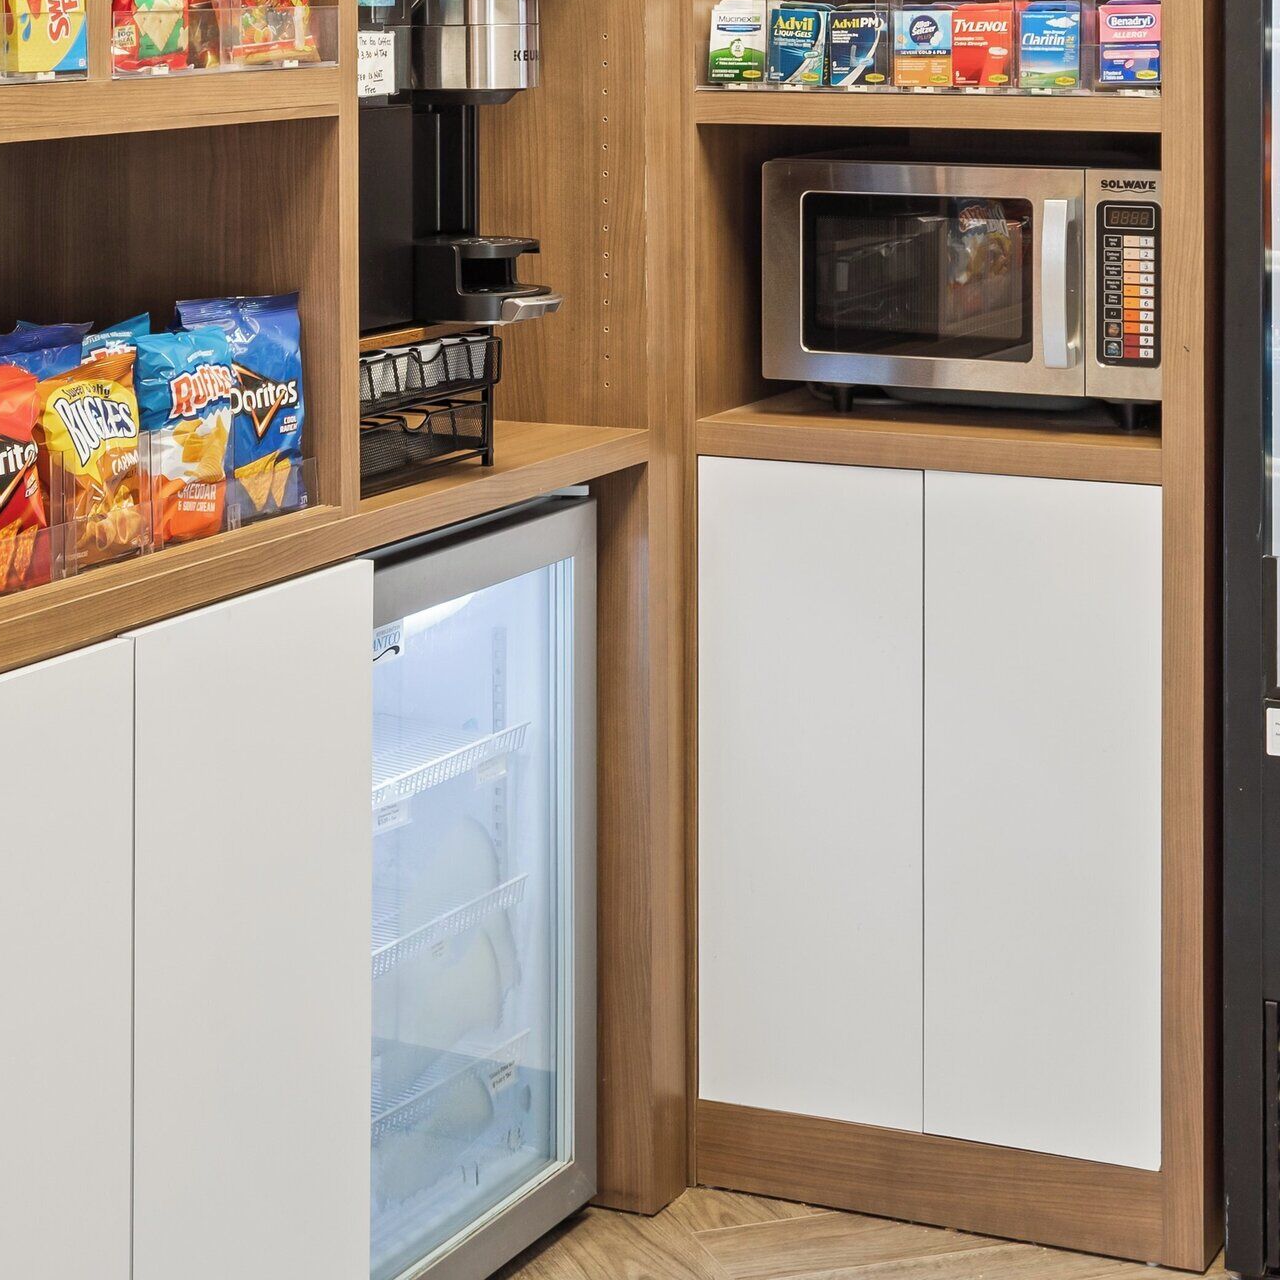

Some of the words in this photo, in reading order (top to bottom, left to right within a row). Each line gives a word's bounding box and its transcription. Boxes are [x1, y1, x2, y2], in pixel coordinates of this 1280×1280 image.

[718, 15, 751, 23] Mucinex
[773, 17, 814, 30] Advil
[832, 18, 859, 29] Advil
[860, 17, 879, 28] PM
[1110, 16, 1152, 27] Benadryl
[953, 19, 1008, 33] TYLENOL
[773, 29, 813, 38] LIQUI-GELS
[1022, 32, 1065, 46] Claritin
[1112, 31, 1148, 39] ALLERGY
[1100, 179, 1156, 191] SOLWAVE
[229, 381, 298, 416] Doritos
[53, 396, 137, 467] BUGLES
